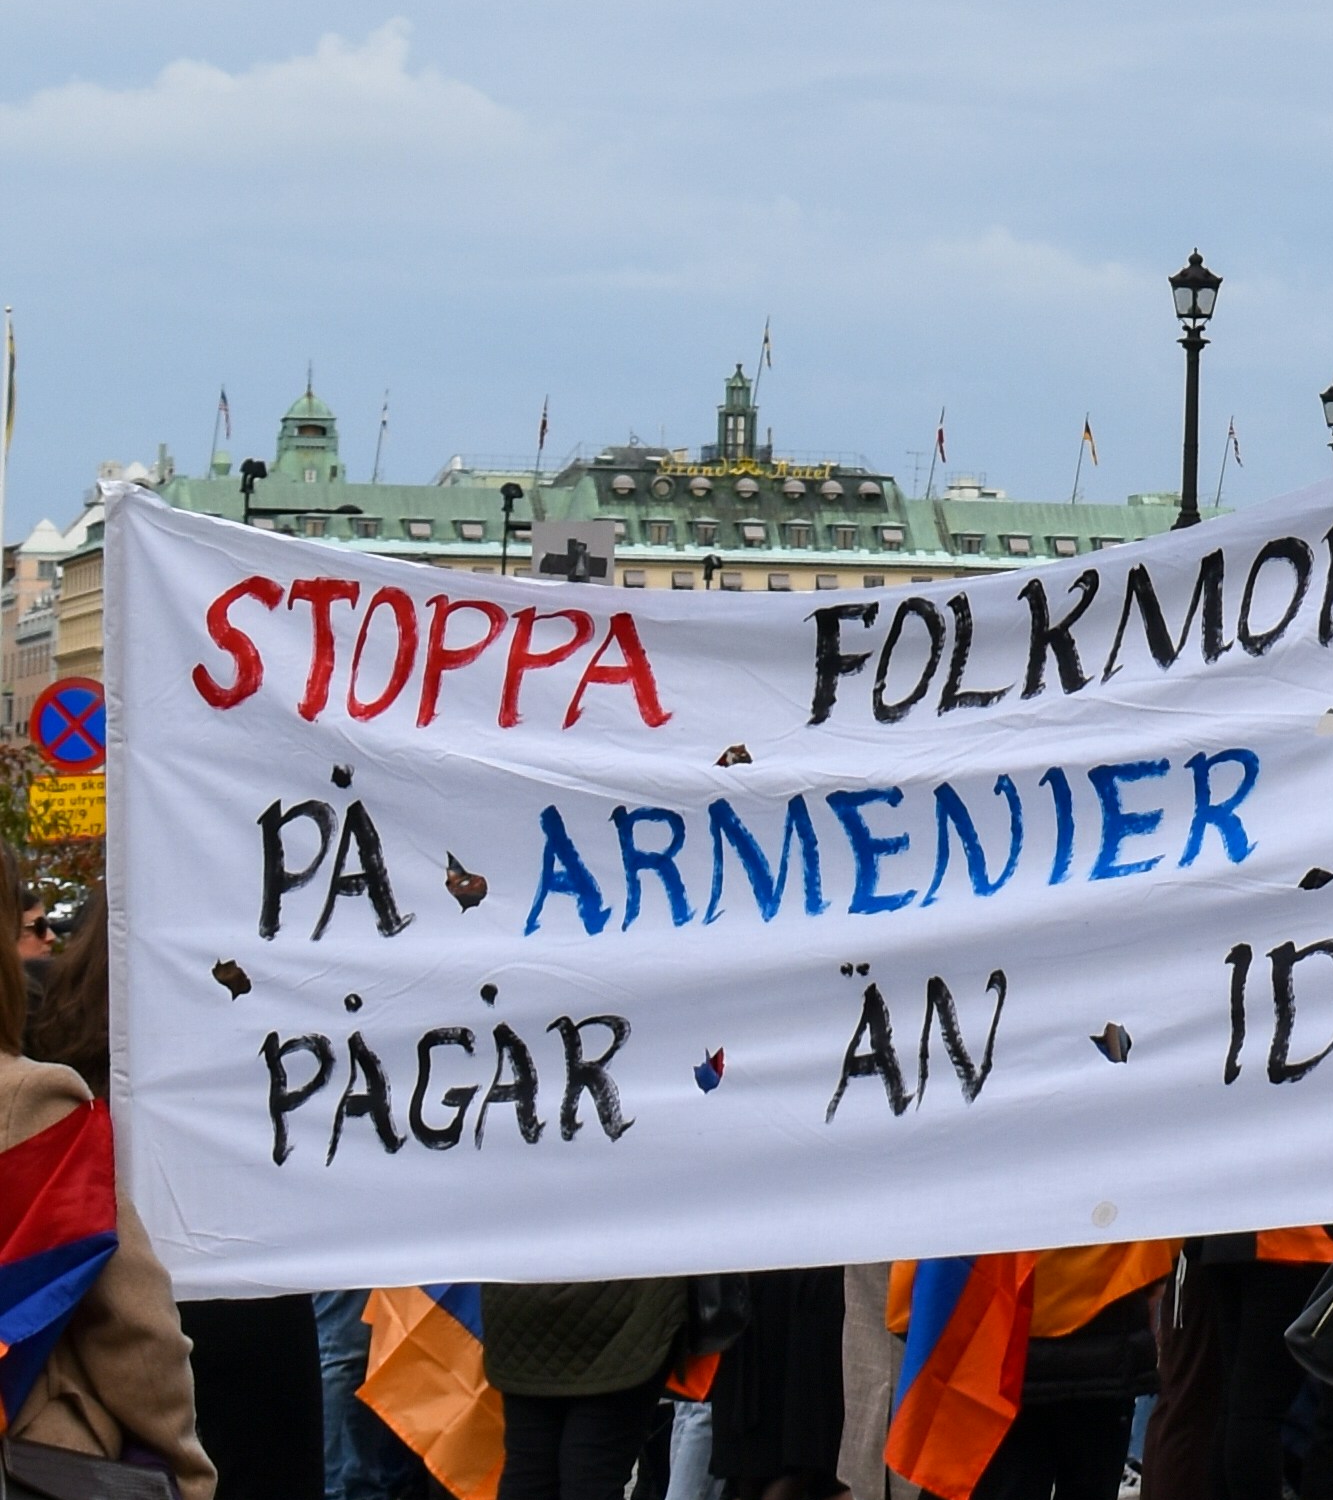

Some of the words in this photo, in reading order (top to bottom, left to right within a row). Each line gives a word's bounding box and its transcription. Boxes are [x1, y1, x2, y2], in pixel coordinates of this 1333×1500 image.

[192, 575, 672, 729] STOPPA
[257, 765, 412, 941] PÅ
[524, 747, 1259, 936] ARMENIER
[258, 984, 635, 1166] PÅGÅR
[826, 963, 1006, 1122] ÄN
